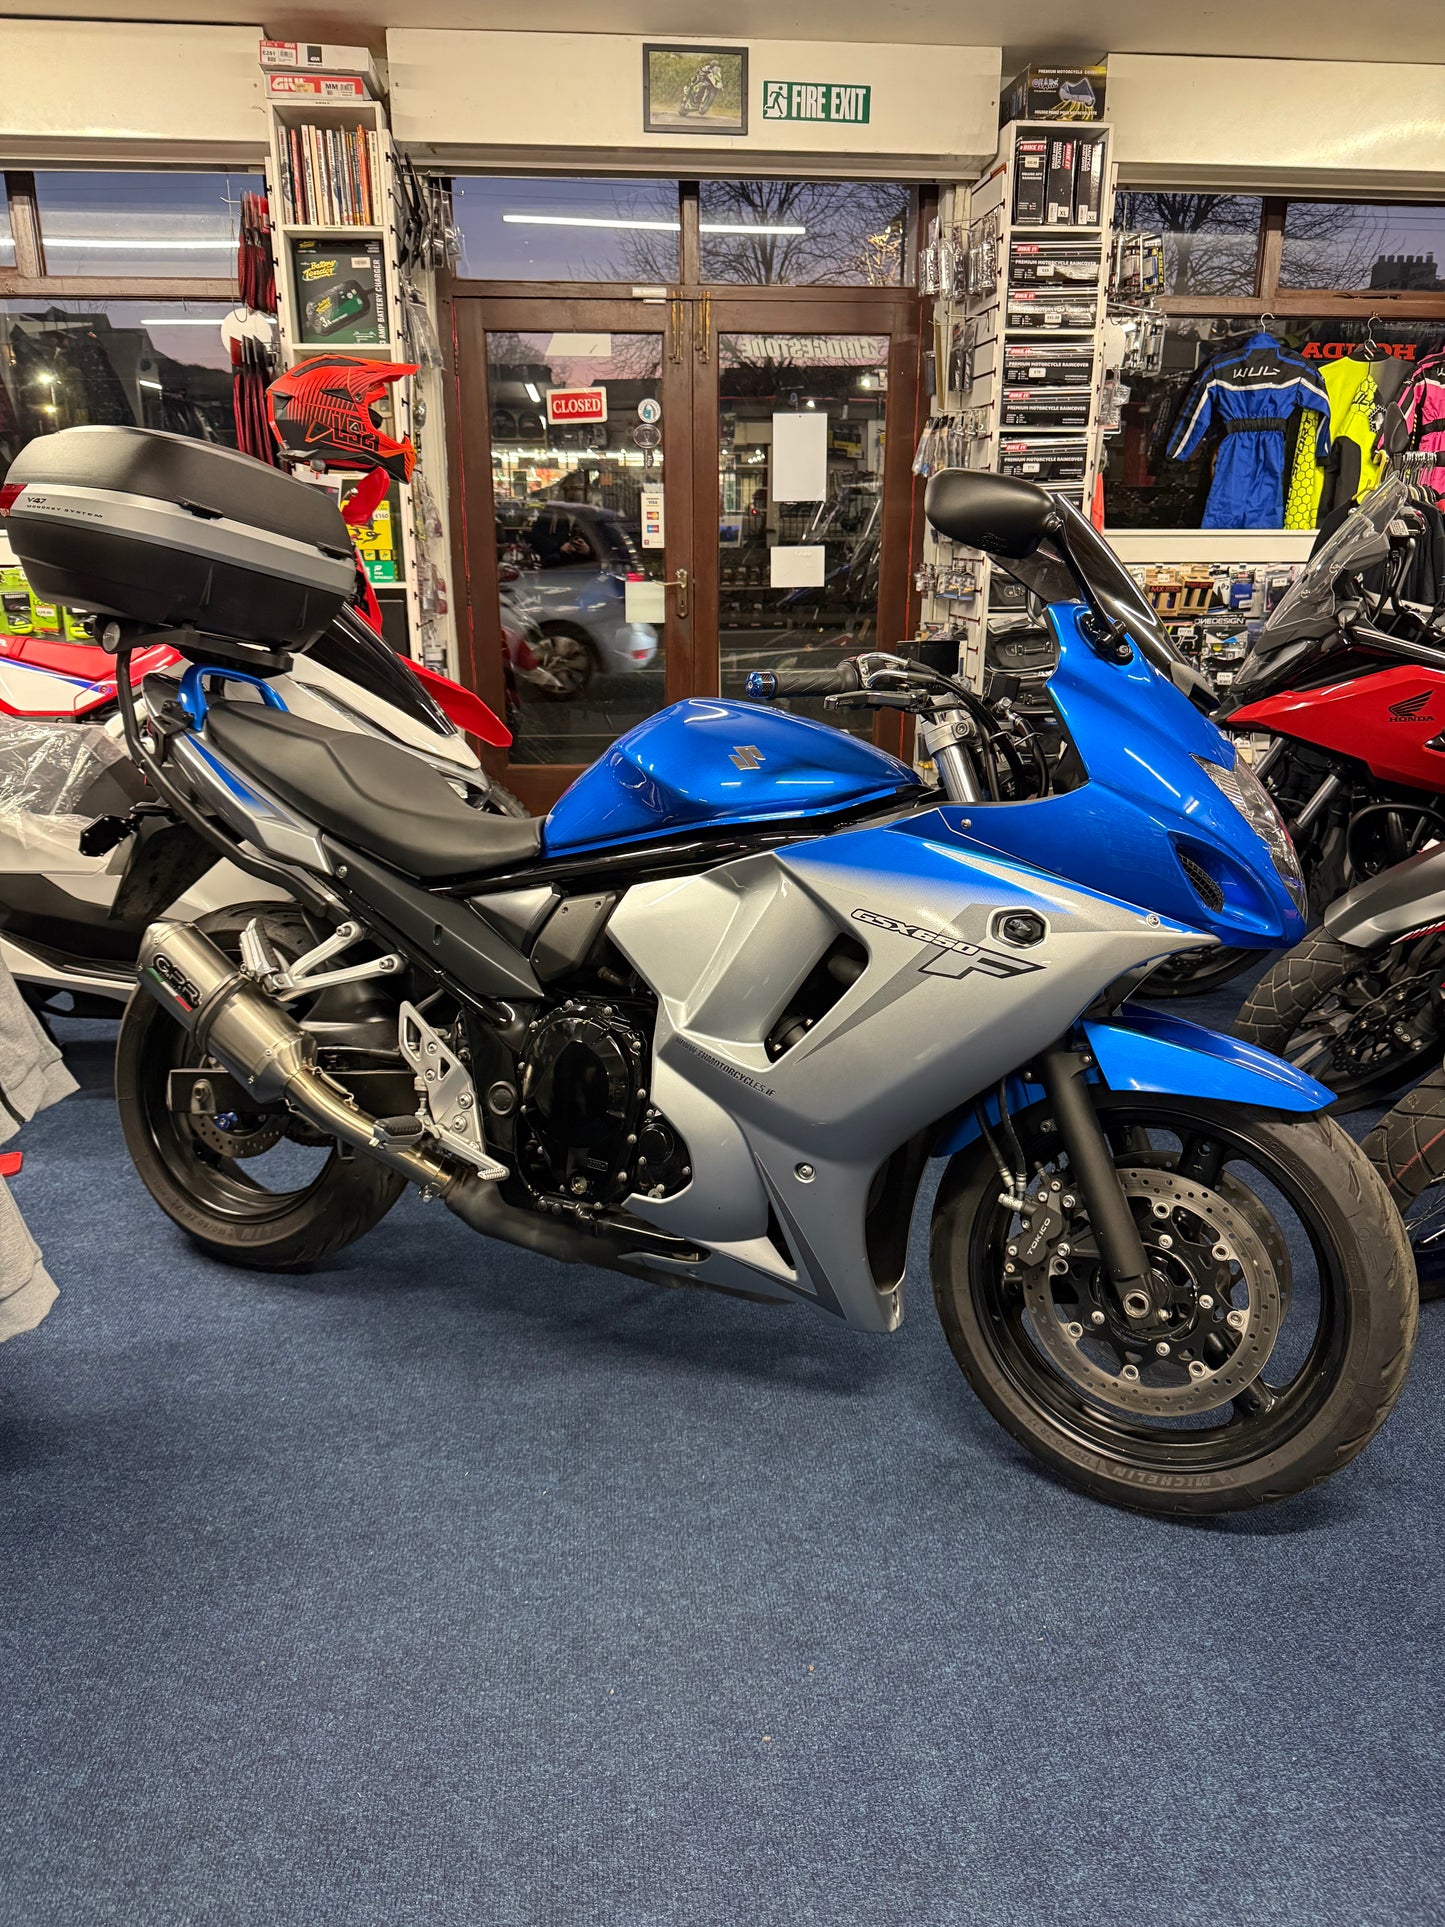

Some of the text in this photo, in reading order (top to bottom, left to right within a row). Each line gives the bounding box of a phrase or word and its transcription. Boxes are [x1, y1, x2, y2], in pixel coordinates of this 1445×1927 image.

[791, 85, 866, 121] FIRE EXIT
[373, 259, 382, 292] CHARGER
[375, 293, 385, 323] BATTERY
[378, 324, 386, 339] AMP
[552, 398, 601, 414] CLOSED
[64, 508, 103, 518] SYSTEM
[1388, 715, 1435, 723] HONDA
[1027, 1217, 1051, 1255] TOKICO
[1112, 1464, 1212, 1487] MICHELIN
